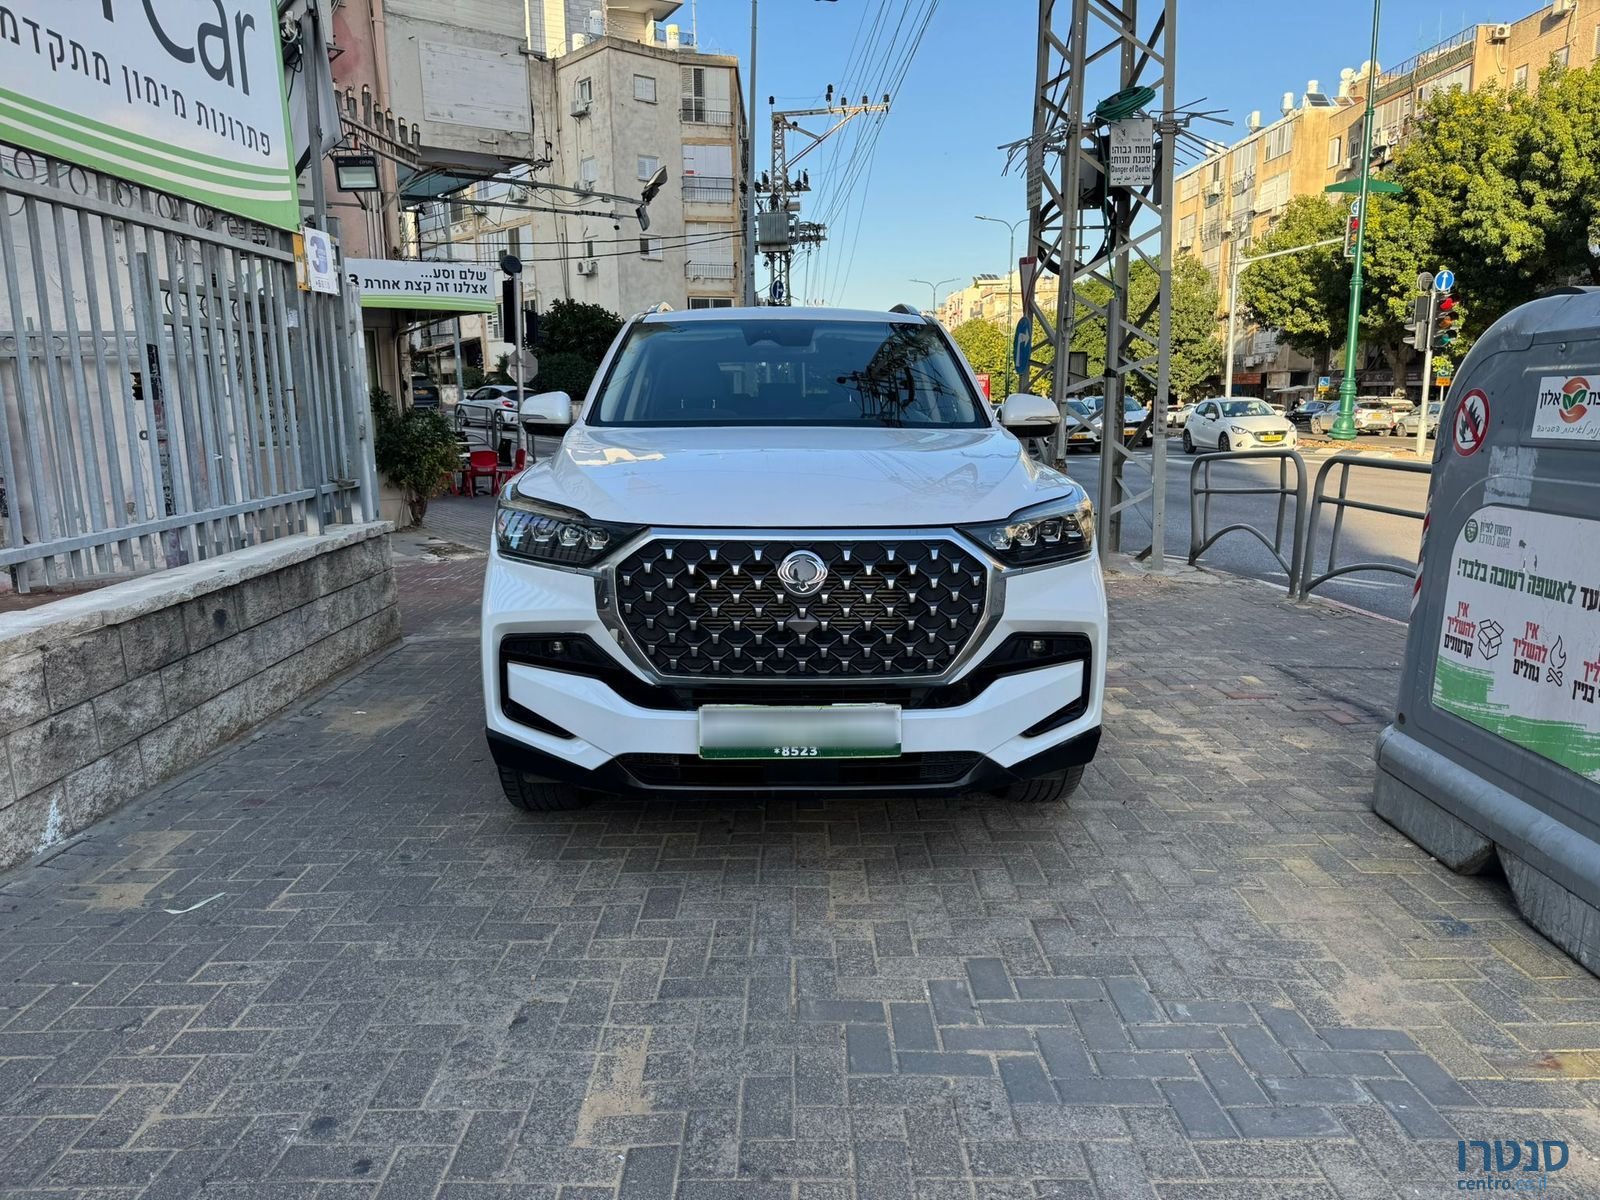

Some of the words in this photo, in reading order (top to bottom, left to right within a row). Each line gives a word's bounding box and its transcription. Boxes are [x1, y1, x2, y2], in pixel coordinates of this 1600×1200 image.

[121, 64, 187, 119] מימון
[195, 100, 270, 156] פתרונות
[1132, 155, 1151, 164] סכנת
[1134, 146, 1151, 154] מתח
[1111, 165, 1128, 174] Danger
[1129, 165, 1135, 173] of
[459, 267, 487, 281] שלם
[364, 278, 401, 291] אחרת
[404, 280, 432, 293] קצת
[436, 281, 450, 293] זה
[453, 281, 488, 295] אצלנו
[1539, 389, 1562, 409] אלון
[1457, 557, 1490, 582] בלבד!
[1489, 565, 1526, 592] רטובה
[1527, 573, 1577, 605] לאשפה
[1457, 600, 1470, 618] אין
[1447, 615, 1477, 639] להשליך
[1525, 620, 1540, 640] אין
[1443, 633, 1474, 659] קרטונים
[1512, 637, 1549, 665] להשליך
[1512, 658, 1540, 683] גחלים
[1572, 679, 1596, 704] בניין
